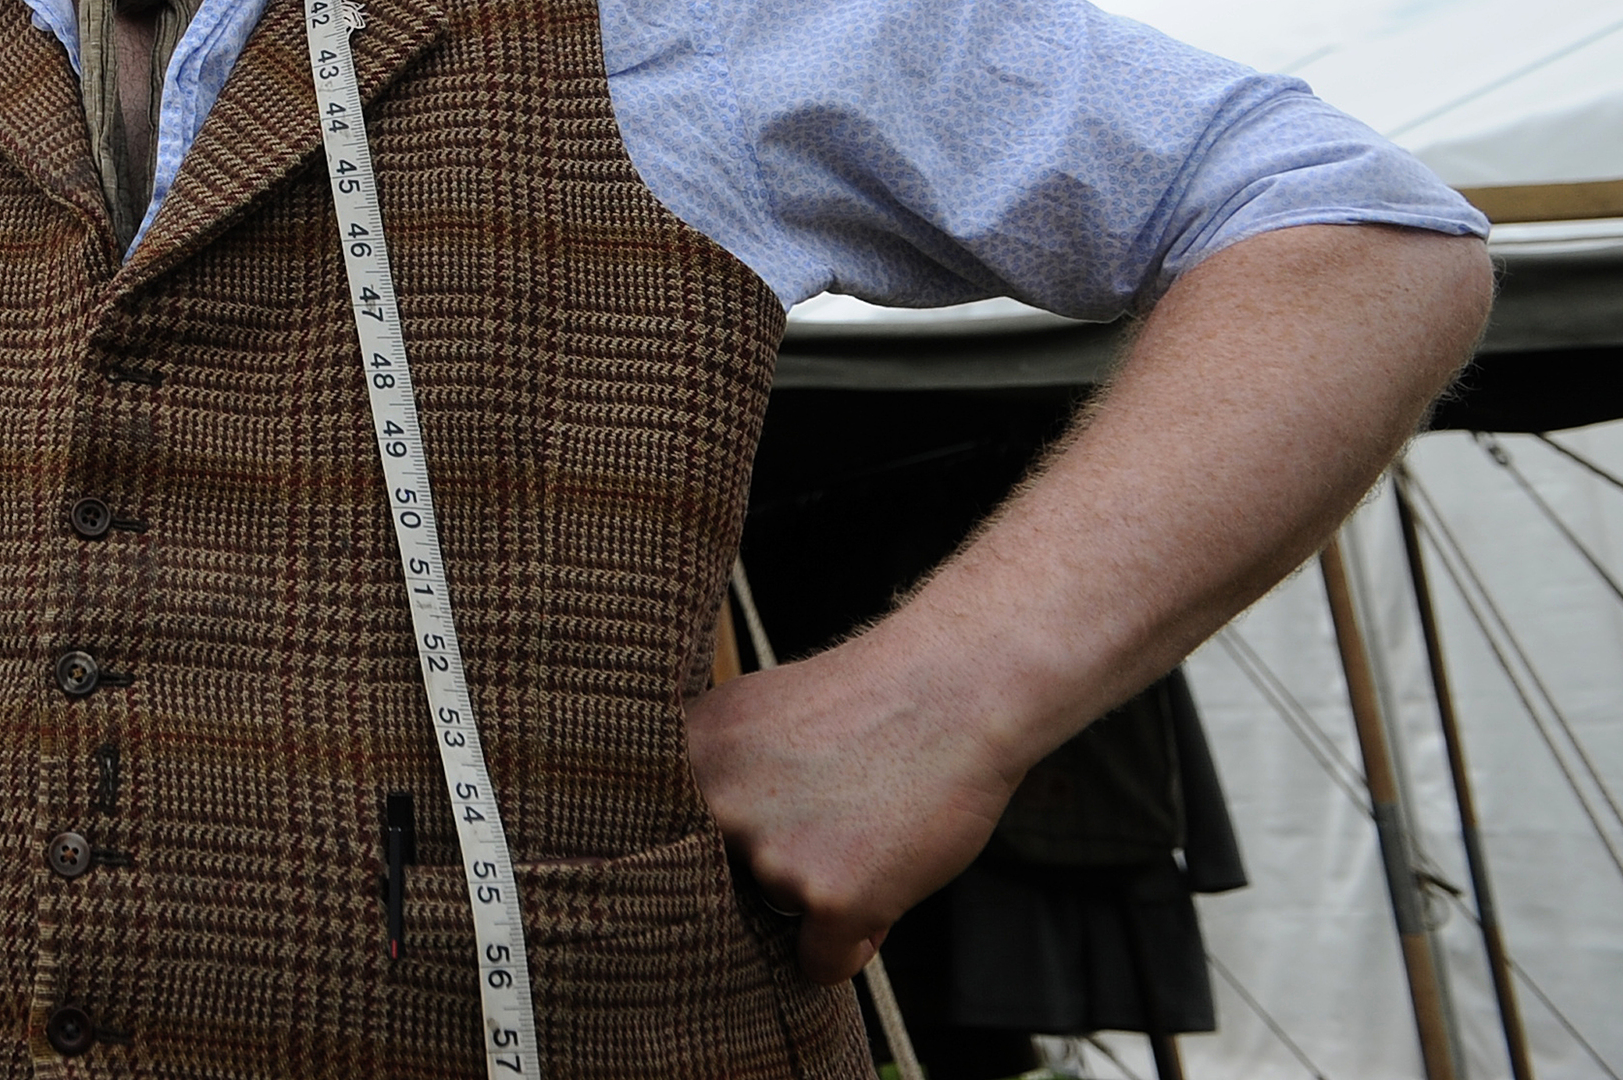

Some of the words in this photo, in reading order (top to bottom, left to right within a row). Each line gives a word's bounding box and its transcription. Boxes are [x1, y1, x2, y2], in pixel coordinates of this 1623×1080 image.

[310, 1, 330, 29] 42
[318, 49, 340, 80] 43
[325, 100, 350, 134] 44
[336, 158, 361, 195] 45
[347, 221, 373, 259] 46
[358, 285, 384, 323] 47
[370, 352, 396, 390] 48
[382, 419, 408, 458] 49
[396, 487, 422, 529] 50
[410, 557, 434, 596] 51
[424, 633, 449, 673] 52
[439, 706, 465, 749] 53
[456, 782, 486, 824] 54
[473, 860, 500, 904] 55
[486, 944, 513, 991] 56
[493, 1028, 522, 1076] 57
